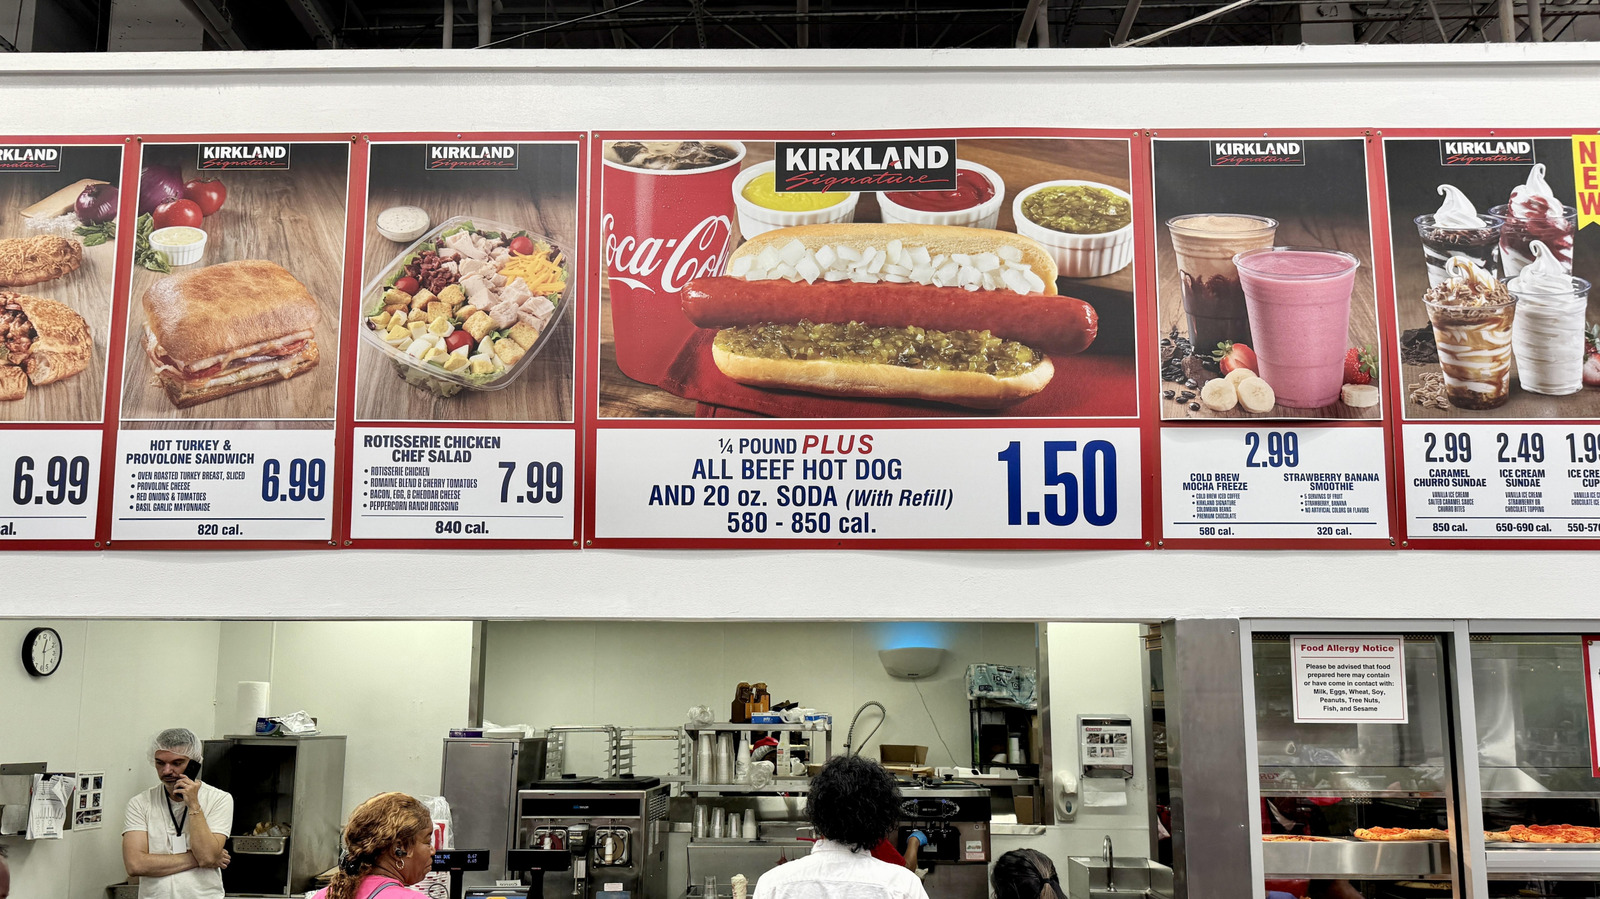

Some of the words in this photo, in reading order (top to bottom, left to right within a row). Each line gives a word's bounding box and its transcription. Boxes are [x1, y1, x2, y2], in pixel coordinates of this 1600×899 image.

[203, 145, 286, 159] KIRKLAND
[431, 145, 514, 159] KIRKLAND
[1216, 142, 1300, 155] KIRKLAND
[1445, 142, 1530, 154] KIRKLAND
[0, 149, 58, 160] KLAND
[786, 146, 949, 170] KIRKLAND
[1216, 154, 1300, 165] Signature
[1446, 153, 1530, 164] Signature
[203, 158, 284, 170] Signature
[431, 158, 514, 170] Signature
[786, 172, 949, 193] Signature
[1579, 141, 1600, 215] NEW
[150, 440, 172, 450] HOT
[176, 440, 219, 450] TURKEY
[223, 440, 231, 450] &
[364, 435, 441, 448] ROTISSERIE
[444, 436, 500, 449] CHICKEN
[739, 438, 797, 454] POUND
[802, 434, 874, 454] PLUS
[1424, 432, 1472, 463] 2.99
[1245, 432, 1299, 468] 2.99
[1496, 433, 1545, 463] 2.49
[1566, 433, 1600, 463] 1.9
[126, 453, 192, 464] PROVOLONE
[195, 453, 254, 464] SANDWICH
[392, 450, 425, 462] CHEF
[428, 450, 472, 462] SALAD
[371, 467, 403, 476] ROTISSERIE
[404, 467, 430, 476] CHICKEN
[692, 459, 733, 480] ALL
[742, 459, 794, 480] BEEF
[803, 459, 844, 480] HOT
[855, 459, 902, 480] DOG
[1429, 469, 1470, 478] CARAMEL
[1500, 469, 1513, 478] ICE
[1515, 469, 1545, 478] CREAM
[1568, 469, 1581, 478] ICE
[1583, 469, 1600, 478] CRE
[13, 456, 90, 505] 6.99
[138, 472, 152, 480] OVEN
[154, 472, 179, 480] ROASTED
[180, 472, 200, 480] TURKEY
[202, 472, 225, 481] BREAST,
[226, 472, 245, 480] SLICED
[262, 458, 326, 502] 6.99
[1190, 473, 1212, 482] COLD
[1215, 473, 1240, 482] BREW
[1284, 473, 1342, 482] STRAWBERRY
[1345, 473, 1379, 482] BANANA
[137, 482, 169, 490] PROVOLONE
[170, 482, 190, 490] CHEESE
[370, 478, 397, 488] ROMAINE
[399, 478, 416, 488] BLEND
[418, 478, 421, 488] &
[423, 478, 445, 488] CHERRY
[447, 478, 477, 488] TOMATOES
[499, 461, 563, 504] 7.99
[998, 440, 1118, 526] 1.50
[1183, 482, 1214, 491] MOCHA
[1217, 482, 1248, 491] FREEZE
[1310, 482, 1354, 491] SMOOTHIE
[1414, 478, 1450, 487] CHURRO
[1452, 478, 1487, 487] SUNDAE
[1506, 478, 1541, 487] SUNDAE
[1582, 479, 1600, 487] CUP
[137, 492, 147, 501] RED
[149, 492, 169, 501] ONIONS
[171, 492, 175, 501] &
[177, 492, 206, 501] TOMATOES
[370, 490, 391, 500] BACON,
[393, 490, 405, 500] EGG,
[406, 490, 411, 499] &
[412, 490, 439, 500] CHEDDAR
[440, 490, 461, 500] CHEESE
[648, 485, 696, 506] AND
[704, 485, 729, 506] 20
[738, 491, 768, 506] oz.
[777, 485, 838, 507] SODA
[846, 489, 893, 510] (With
[899, 489, 953, 510] Refill)
[136, 503, 151, 512] BASIL
[153, 503, 172, 512] GARLIC
[174, 503, 210, 512] MAYONNAISE
[370, 501, 407, 511] PEPPERCORN
[409, 501, 428, 511] RANCH
[430, 501, 459, 511] DRESSING
[435, 521, 462, 534] 840
[465, 521, 489, 534] cal.
[727, 512, 767, 534] 580
[791, 512, 830, 534] 850
[839, 512, 876, 534] cal.
[1433, 523, 1450, 532] 850
[1452, 523, 1468, 532] cal.
[1496, 523, 1533, 532] 650-690
[1536, 523, 1552, 532] cal.
[198, 524, 218, 535] 820
[222, 524, 243, 535] cal.
[1199, 527, 1215, 535] 580
[1218, 527, 1234, 535] cal.
[1317, 527, 1333, 535] 320
[1335, 527, 1352, 535] cal.
[1327, 644, 1360, 653] Allergy
